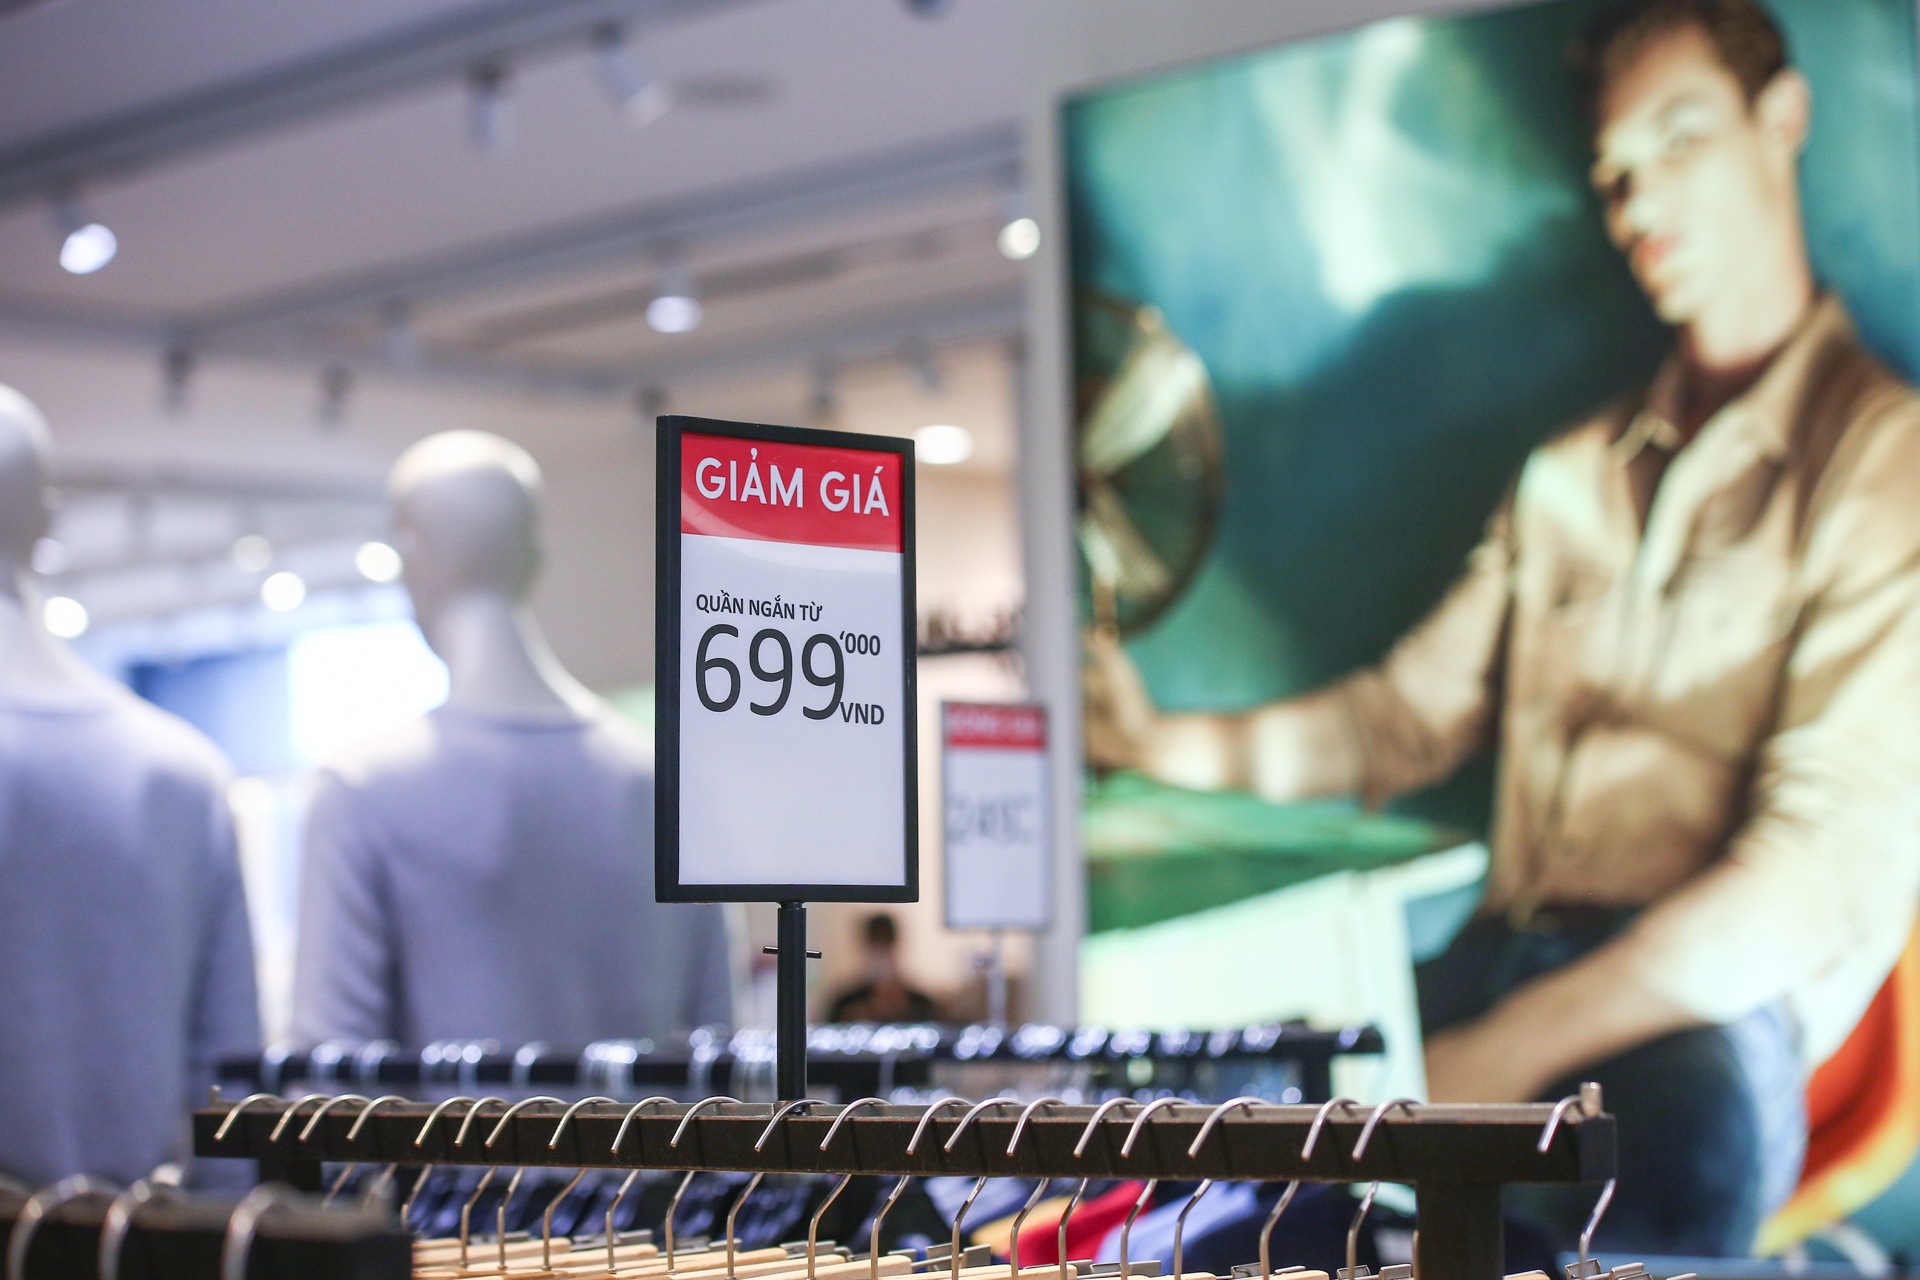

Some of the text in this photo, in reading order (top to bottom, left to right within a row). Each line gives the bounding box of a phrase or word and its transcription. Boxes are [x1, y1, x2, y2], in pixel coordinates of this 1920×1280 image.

[695, 448, 889, 517] GIẢM GIÁ
[696, 590, 823, 622] QUẦN NGẮN TỪ
[695, 623, 845, 720] 699
[839, 702, 885, 725] VND
